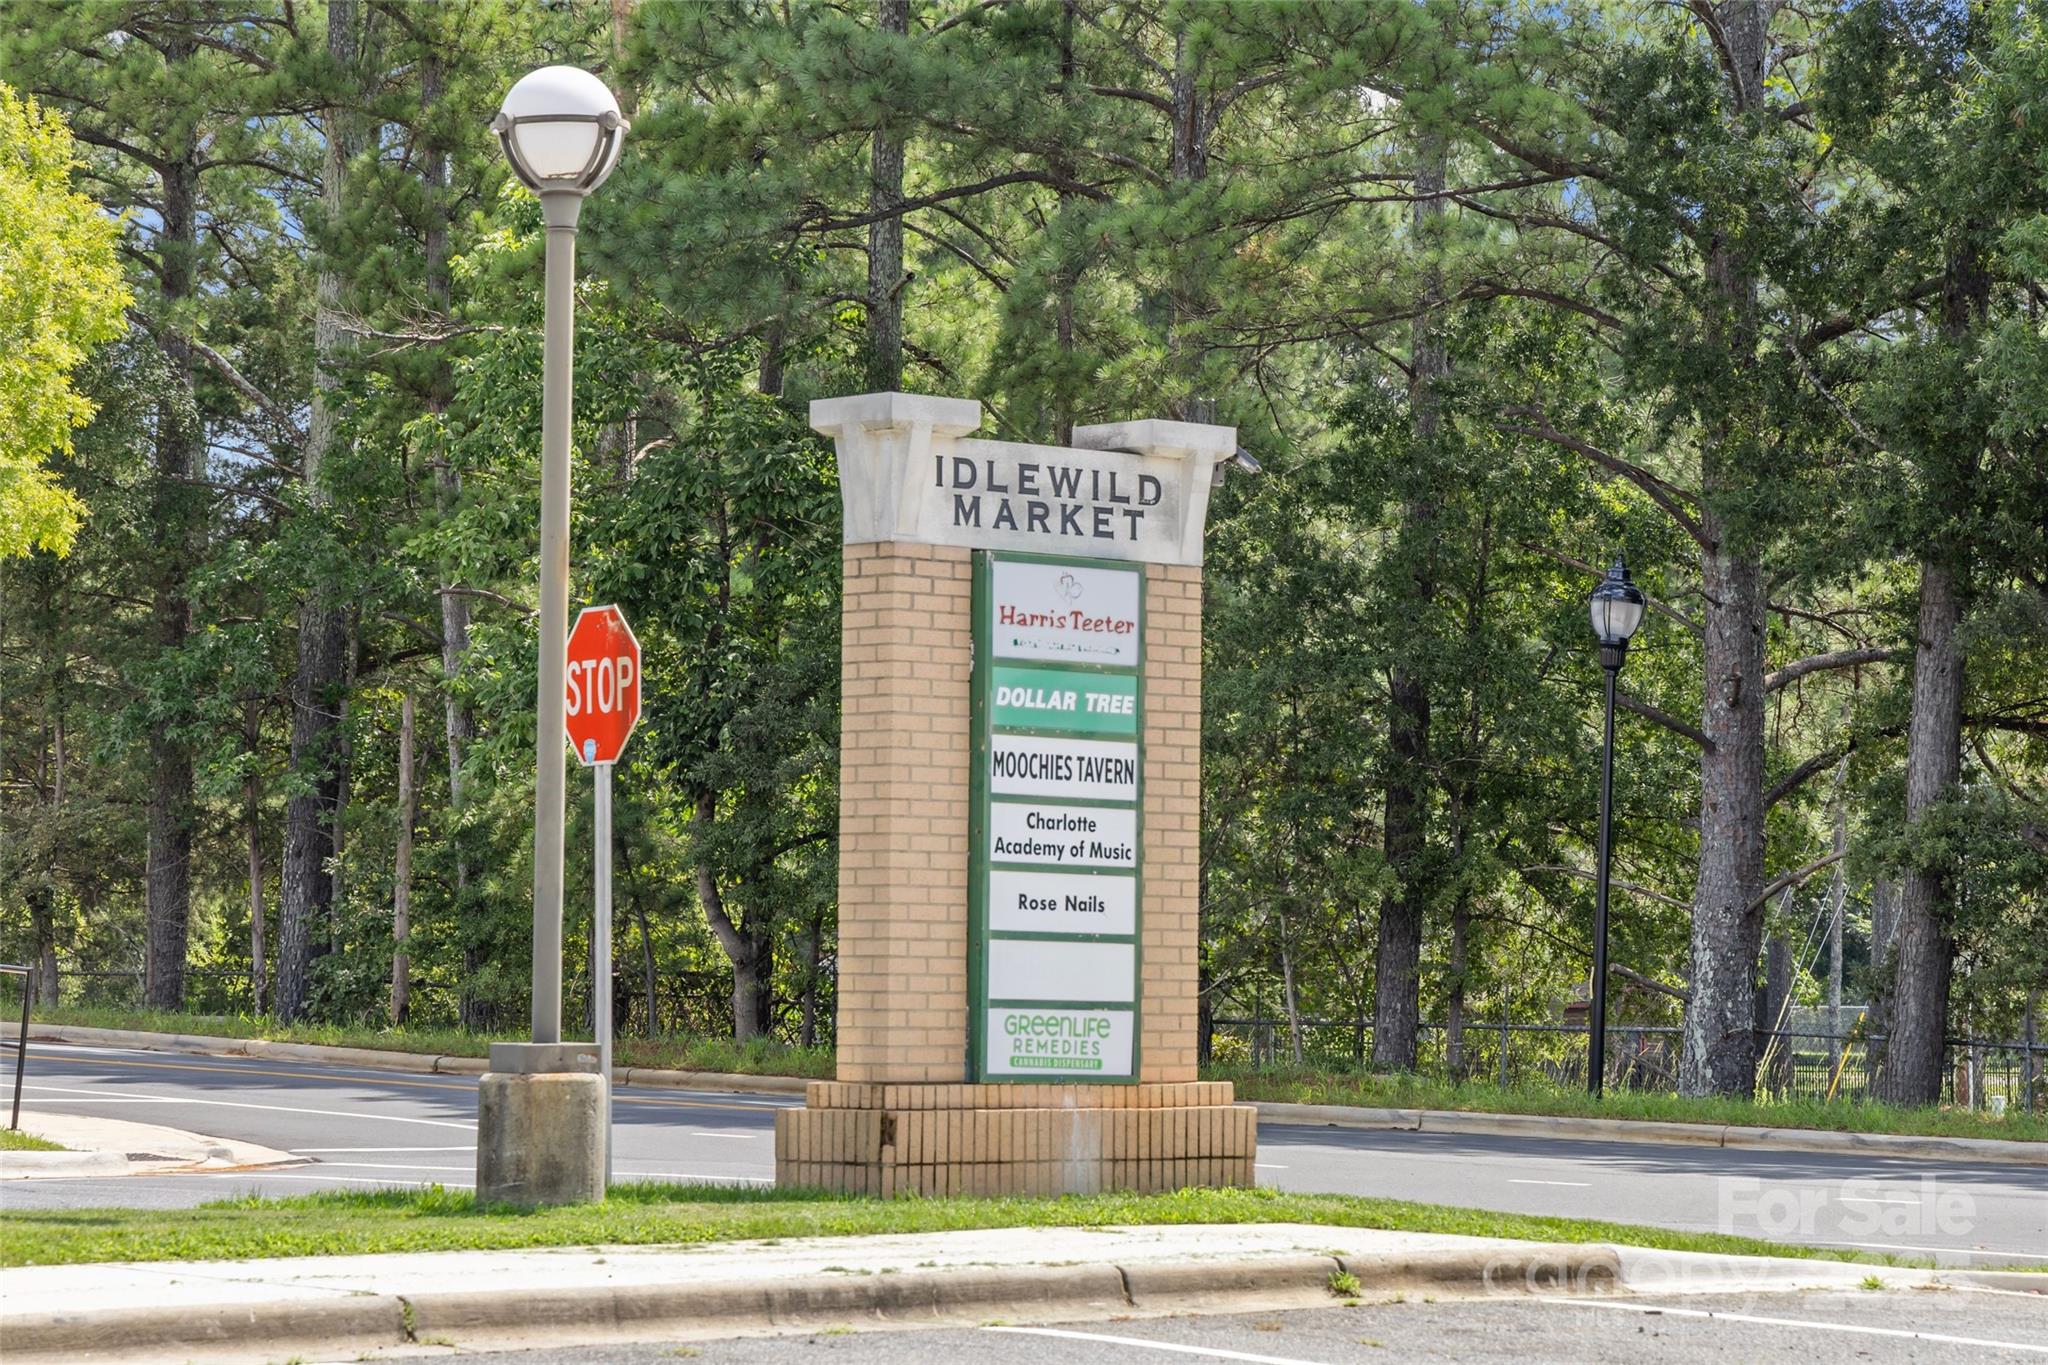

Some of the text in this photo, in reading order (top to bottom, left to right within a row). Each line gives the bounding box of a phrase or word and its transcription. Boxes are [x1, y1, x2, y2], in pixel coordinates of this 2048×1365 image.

[935, 455, 1162, 506] IDLEWILD
[953, 494, 1145, 541] MARKET
[999, 605, 1135, 635] Harris Teeter
[566, 656, 634, 717] STOP
[996, 687, 1135, 714] DOLLAR TREE
[992, 751, 1135, 785] MOOCHIES TAVERN
[1026, 812, 1097, 832] Charlotte
[994, 836, 1132, 861] Academy of Music
[1018, 894, 1105, 913] Rose Nails
[1013, 1038, 1100, 1055] REMEDIES
